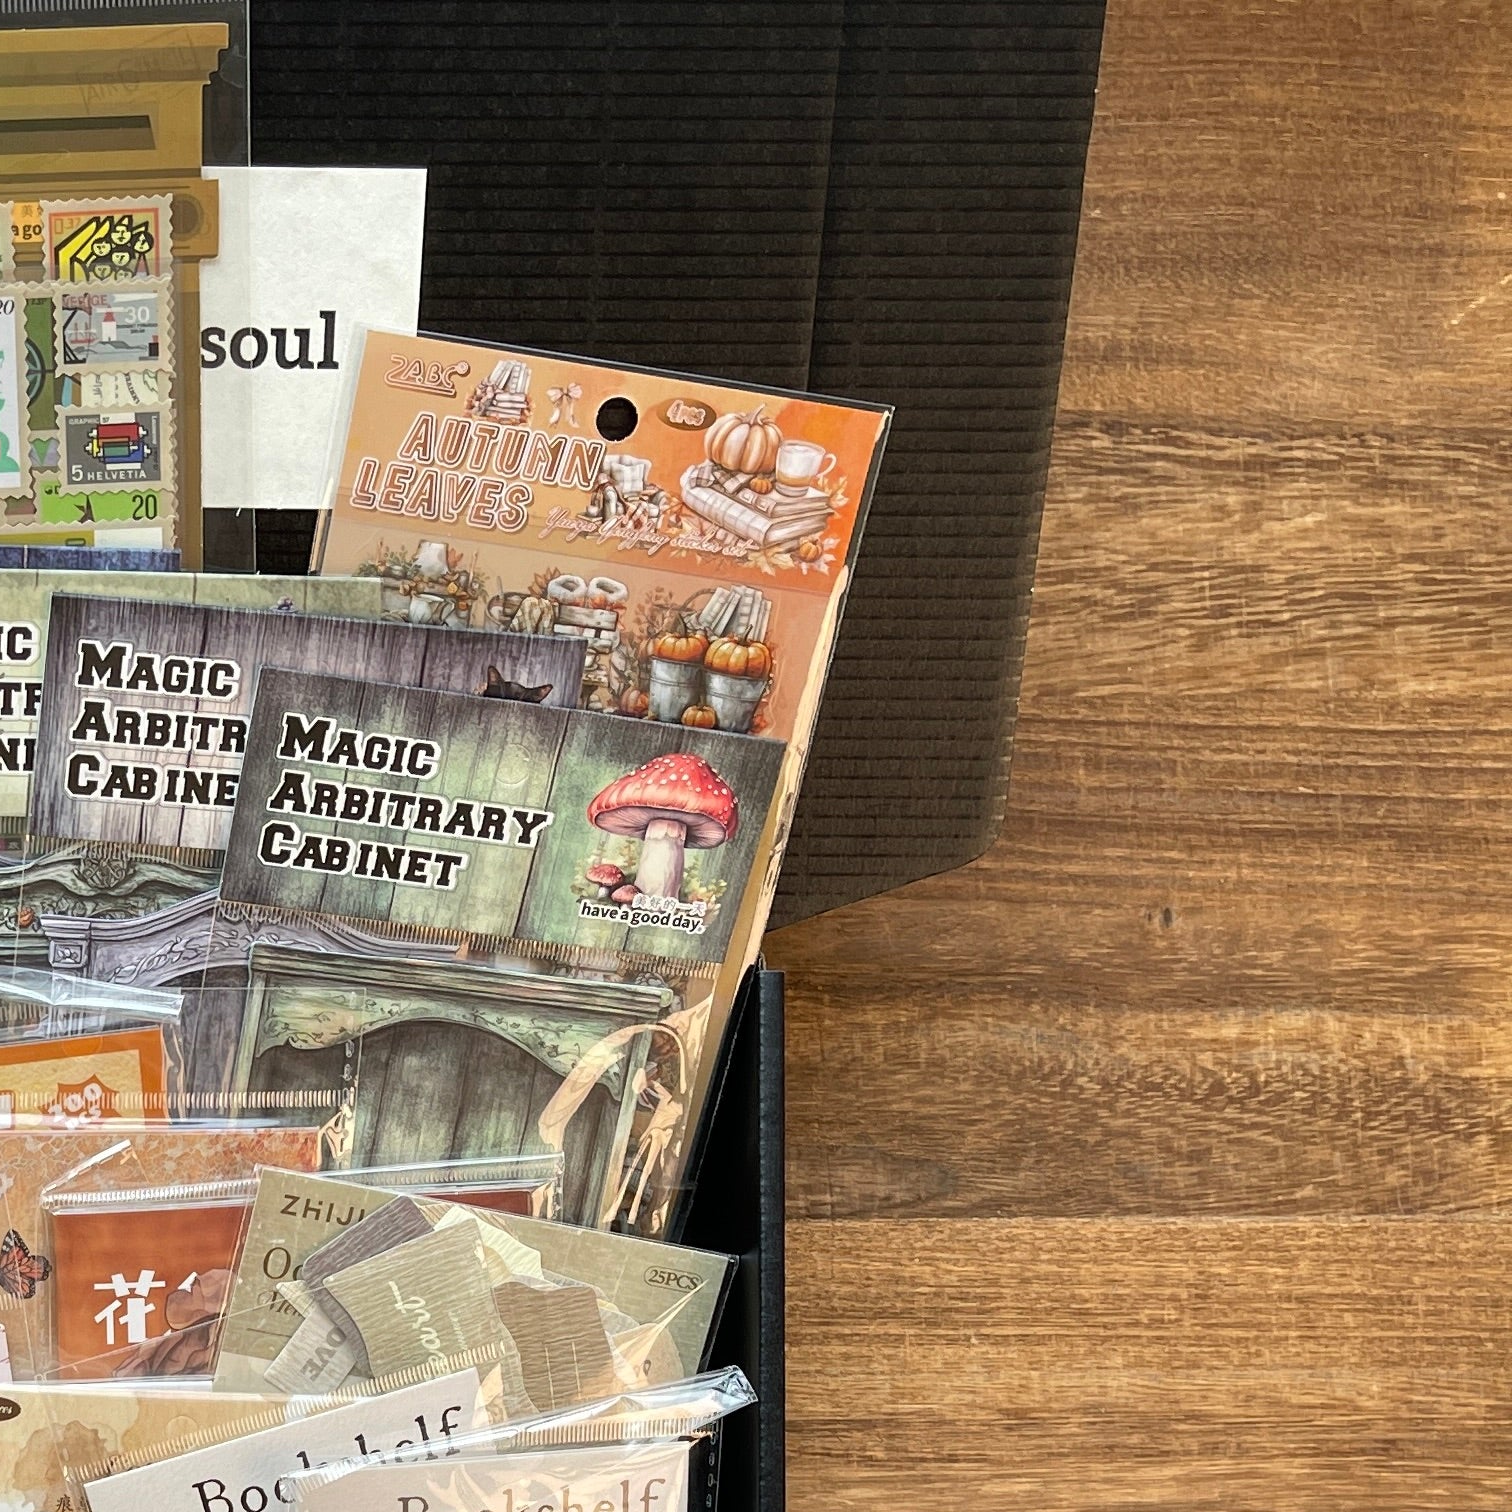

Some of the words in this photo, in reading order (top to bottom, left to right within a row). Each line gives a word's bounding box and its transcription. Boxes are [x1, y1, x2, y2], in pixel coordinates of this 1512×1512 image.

[22, 224, 42, 240] go
[124, 305, 150, 323] 30
[201, 310, 339, 371] soul
[399, 411, 607, 491] AUTUMN
[70, 464, 85, 483] 5
[87, 469, 148, 482] HELVETIA
[131, 494, 158, 521] 20
[351, 457, 535, 533] LEAVES
[74, 637, 243, 702] MAGIC
[274, 711, 443, 779] MAGIC
[266, 768, 555, 850] ARBITRARY
[256, 822, 470, 894] CABINET
[580, 901, 619, 919] have
[620, 909, 630, 921] a
[630, 911, 672, 926] good
[633, 893, 706, 916] 美好的一天
[648, 1267, 700, 1291] 25PCS
